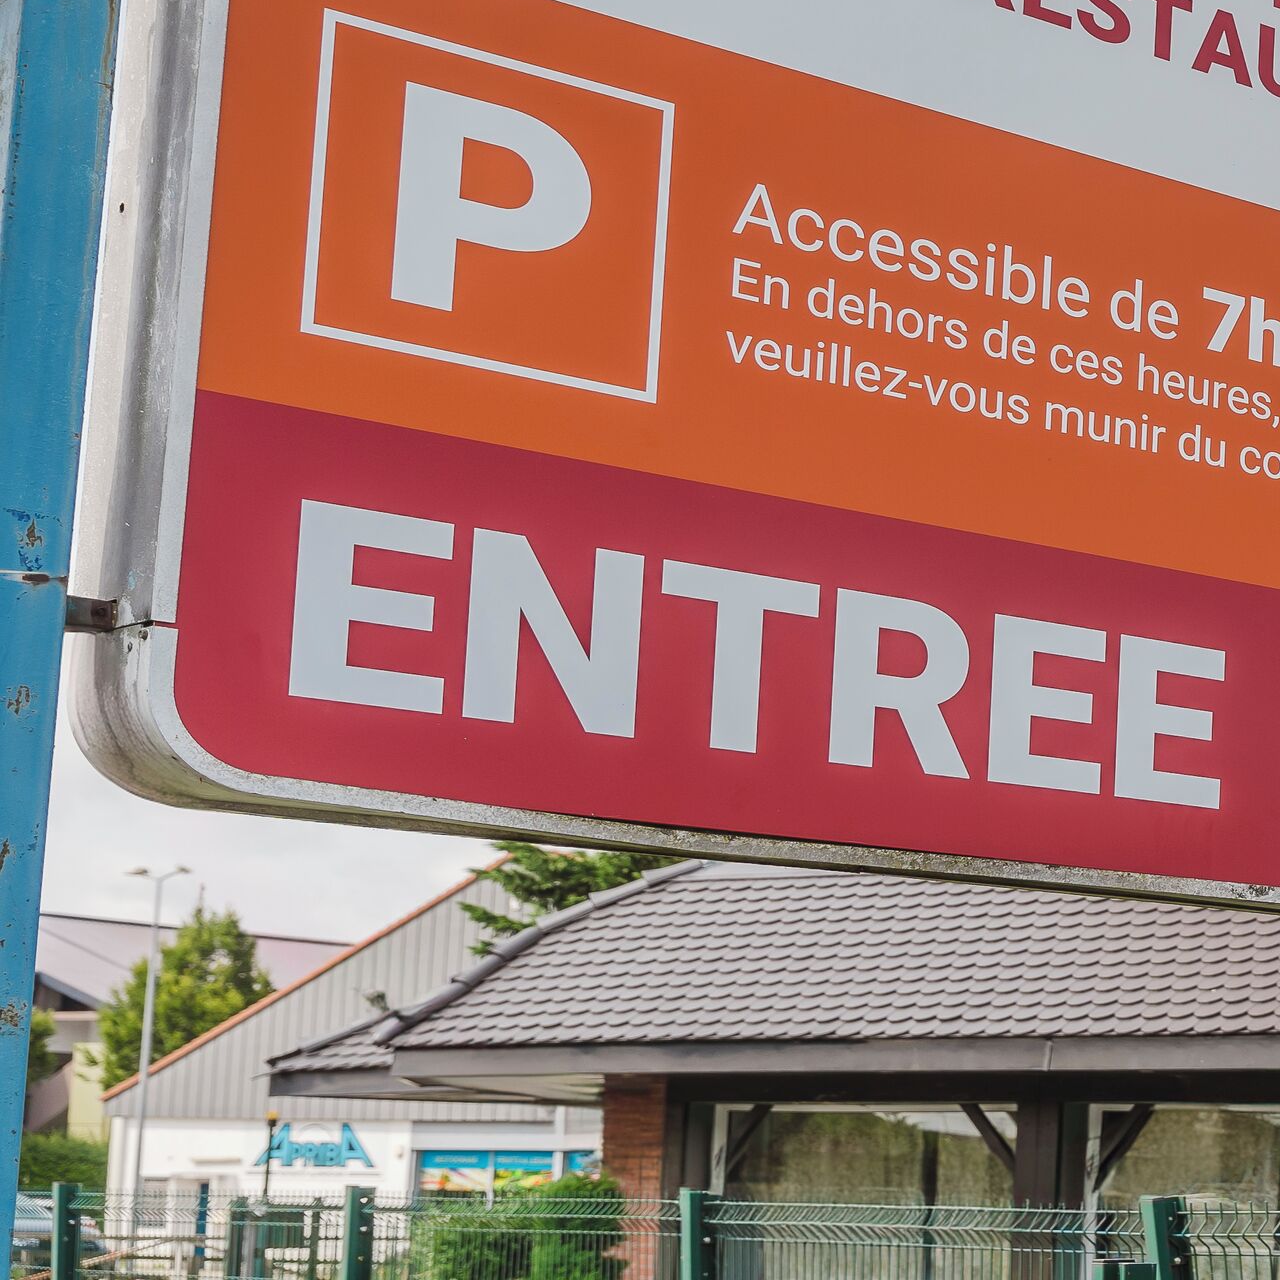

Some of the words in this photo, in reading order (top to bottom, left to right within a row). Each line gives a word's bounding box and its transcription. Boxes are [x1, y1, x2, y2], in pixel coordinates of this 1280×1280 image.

[390, 80, 592, 312] P
[732, 182, 1090, 318] Accessible
[1109, 278, 1179, 340] de
[726, 330, 1030, 425] veuillez-vous
[1045, 401, 1166, 454] munir
[1177, 423, 1226, 468] du
[731, 257, 790, 310] En
[807, 278, 968, 350] dehors
[983, 319, 1036, 365] de
[1049, 342, 1124, 386] ces
[1137, 352, 1280, 429] heures,
[287, 497, 1226, 811] ENTREE
